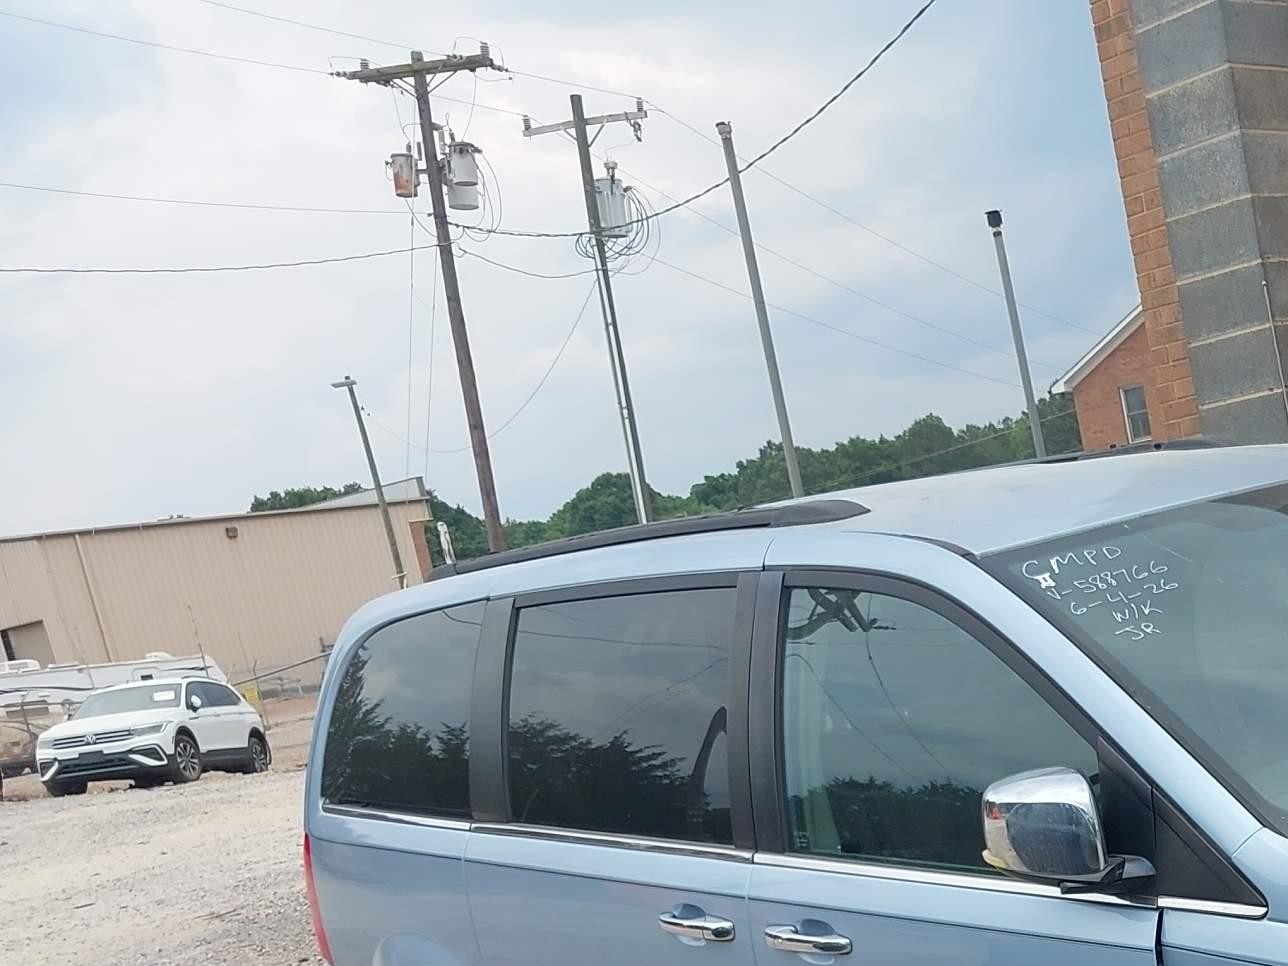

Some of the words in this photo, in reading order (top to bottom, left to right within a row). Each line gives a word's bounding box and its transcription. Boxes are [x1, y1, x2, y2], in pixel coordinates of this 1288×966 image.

[1022, 546, 1122, 579] CMPD
[1070, 579, 1179, 615] 6-4-26
[1115, 622, 1162, 641] JR
